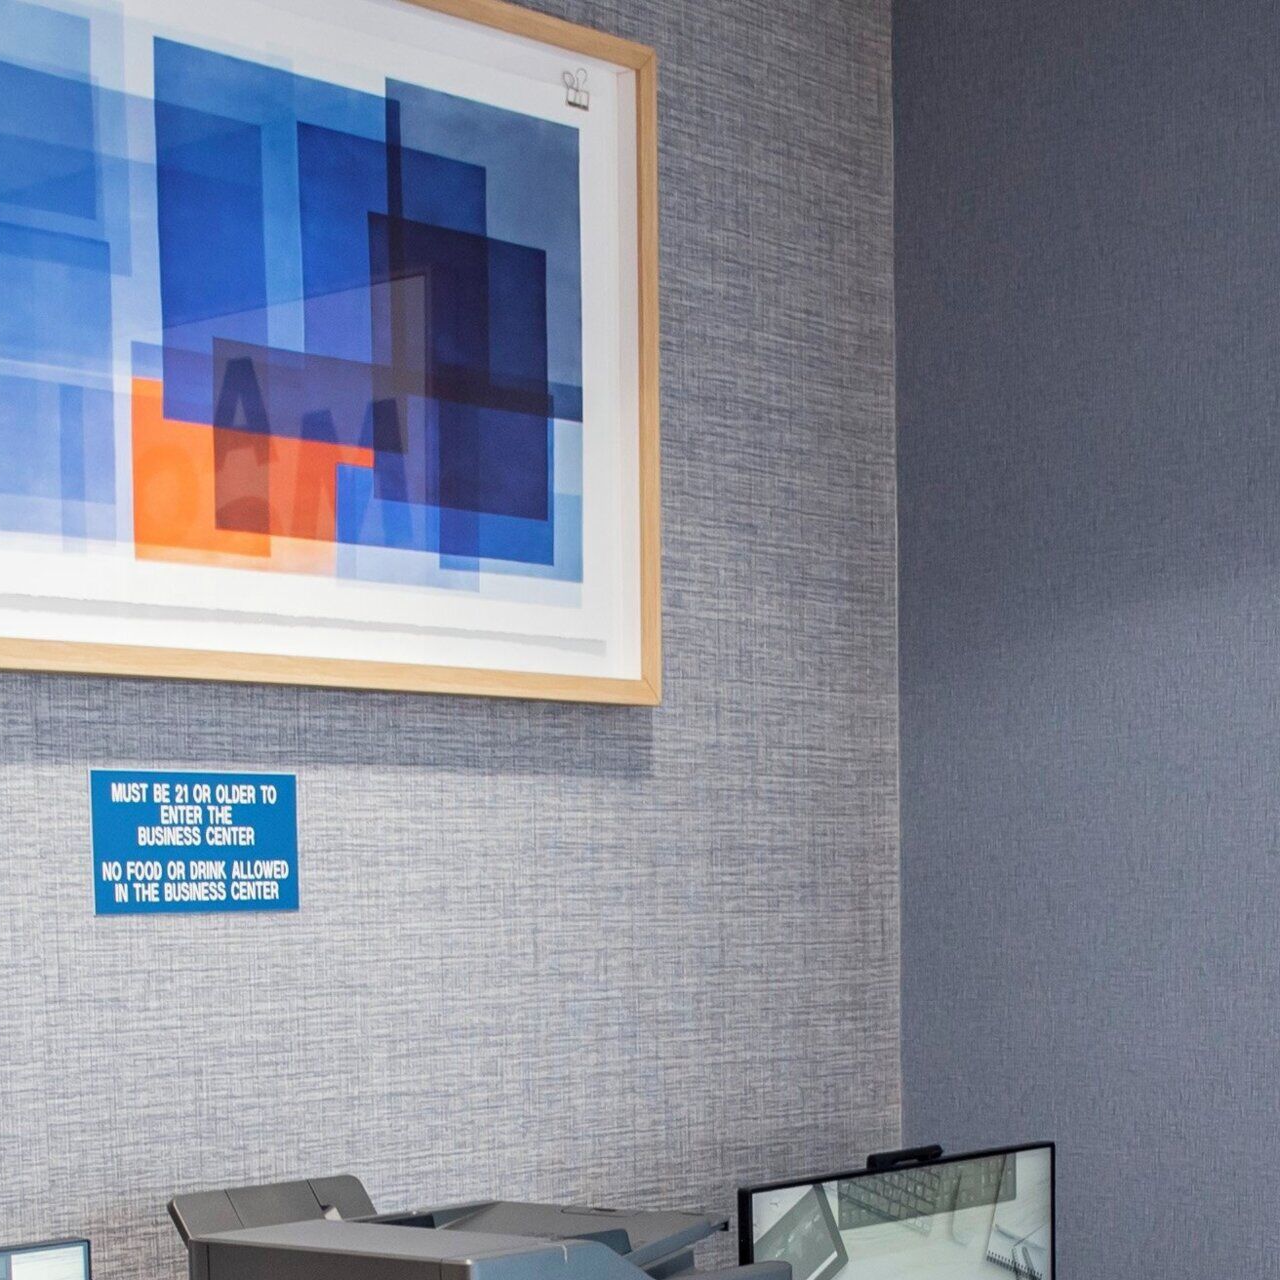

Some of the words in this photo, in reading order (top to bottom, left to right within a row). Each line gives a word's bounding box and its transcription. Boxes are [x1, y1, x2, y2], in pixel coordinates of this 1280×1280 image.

[111, 782, 148, 803] MUST
[153, 783, 171, 804] BE
[175, 784, 188, 804] 21
[193, 784, 211, 803] OR
[216, 784, 256, 804] OLDER
[260, 784, 277, 805] TO
[160, 805, 203, 825] ENTER
[208, 806, 233, 825] THE
[138, 826, 201, 846] BUSINESS
[206, 826, 255, 846] CENTER
[102, 861, 122, 881] NO
[126, 862, 163, 881] FOOD
[167, 861, 186, 881] OR
[190, 861, 227, 880] DRINK
[232, 860, 289, 880] ALLOWED
[115, 883, 128, 903] IN
[133, 883, 160, 903] THE
[164, 883, 227, 902] BUSINESS
[231, 881, 280, 901] CENTER
